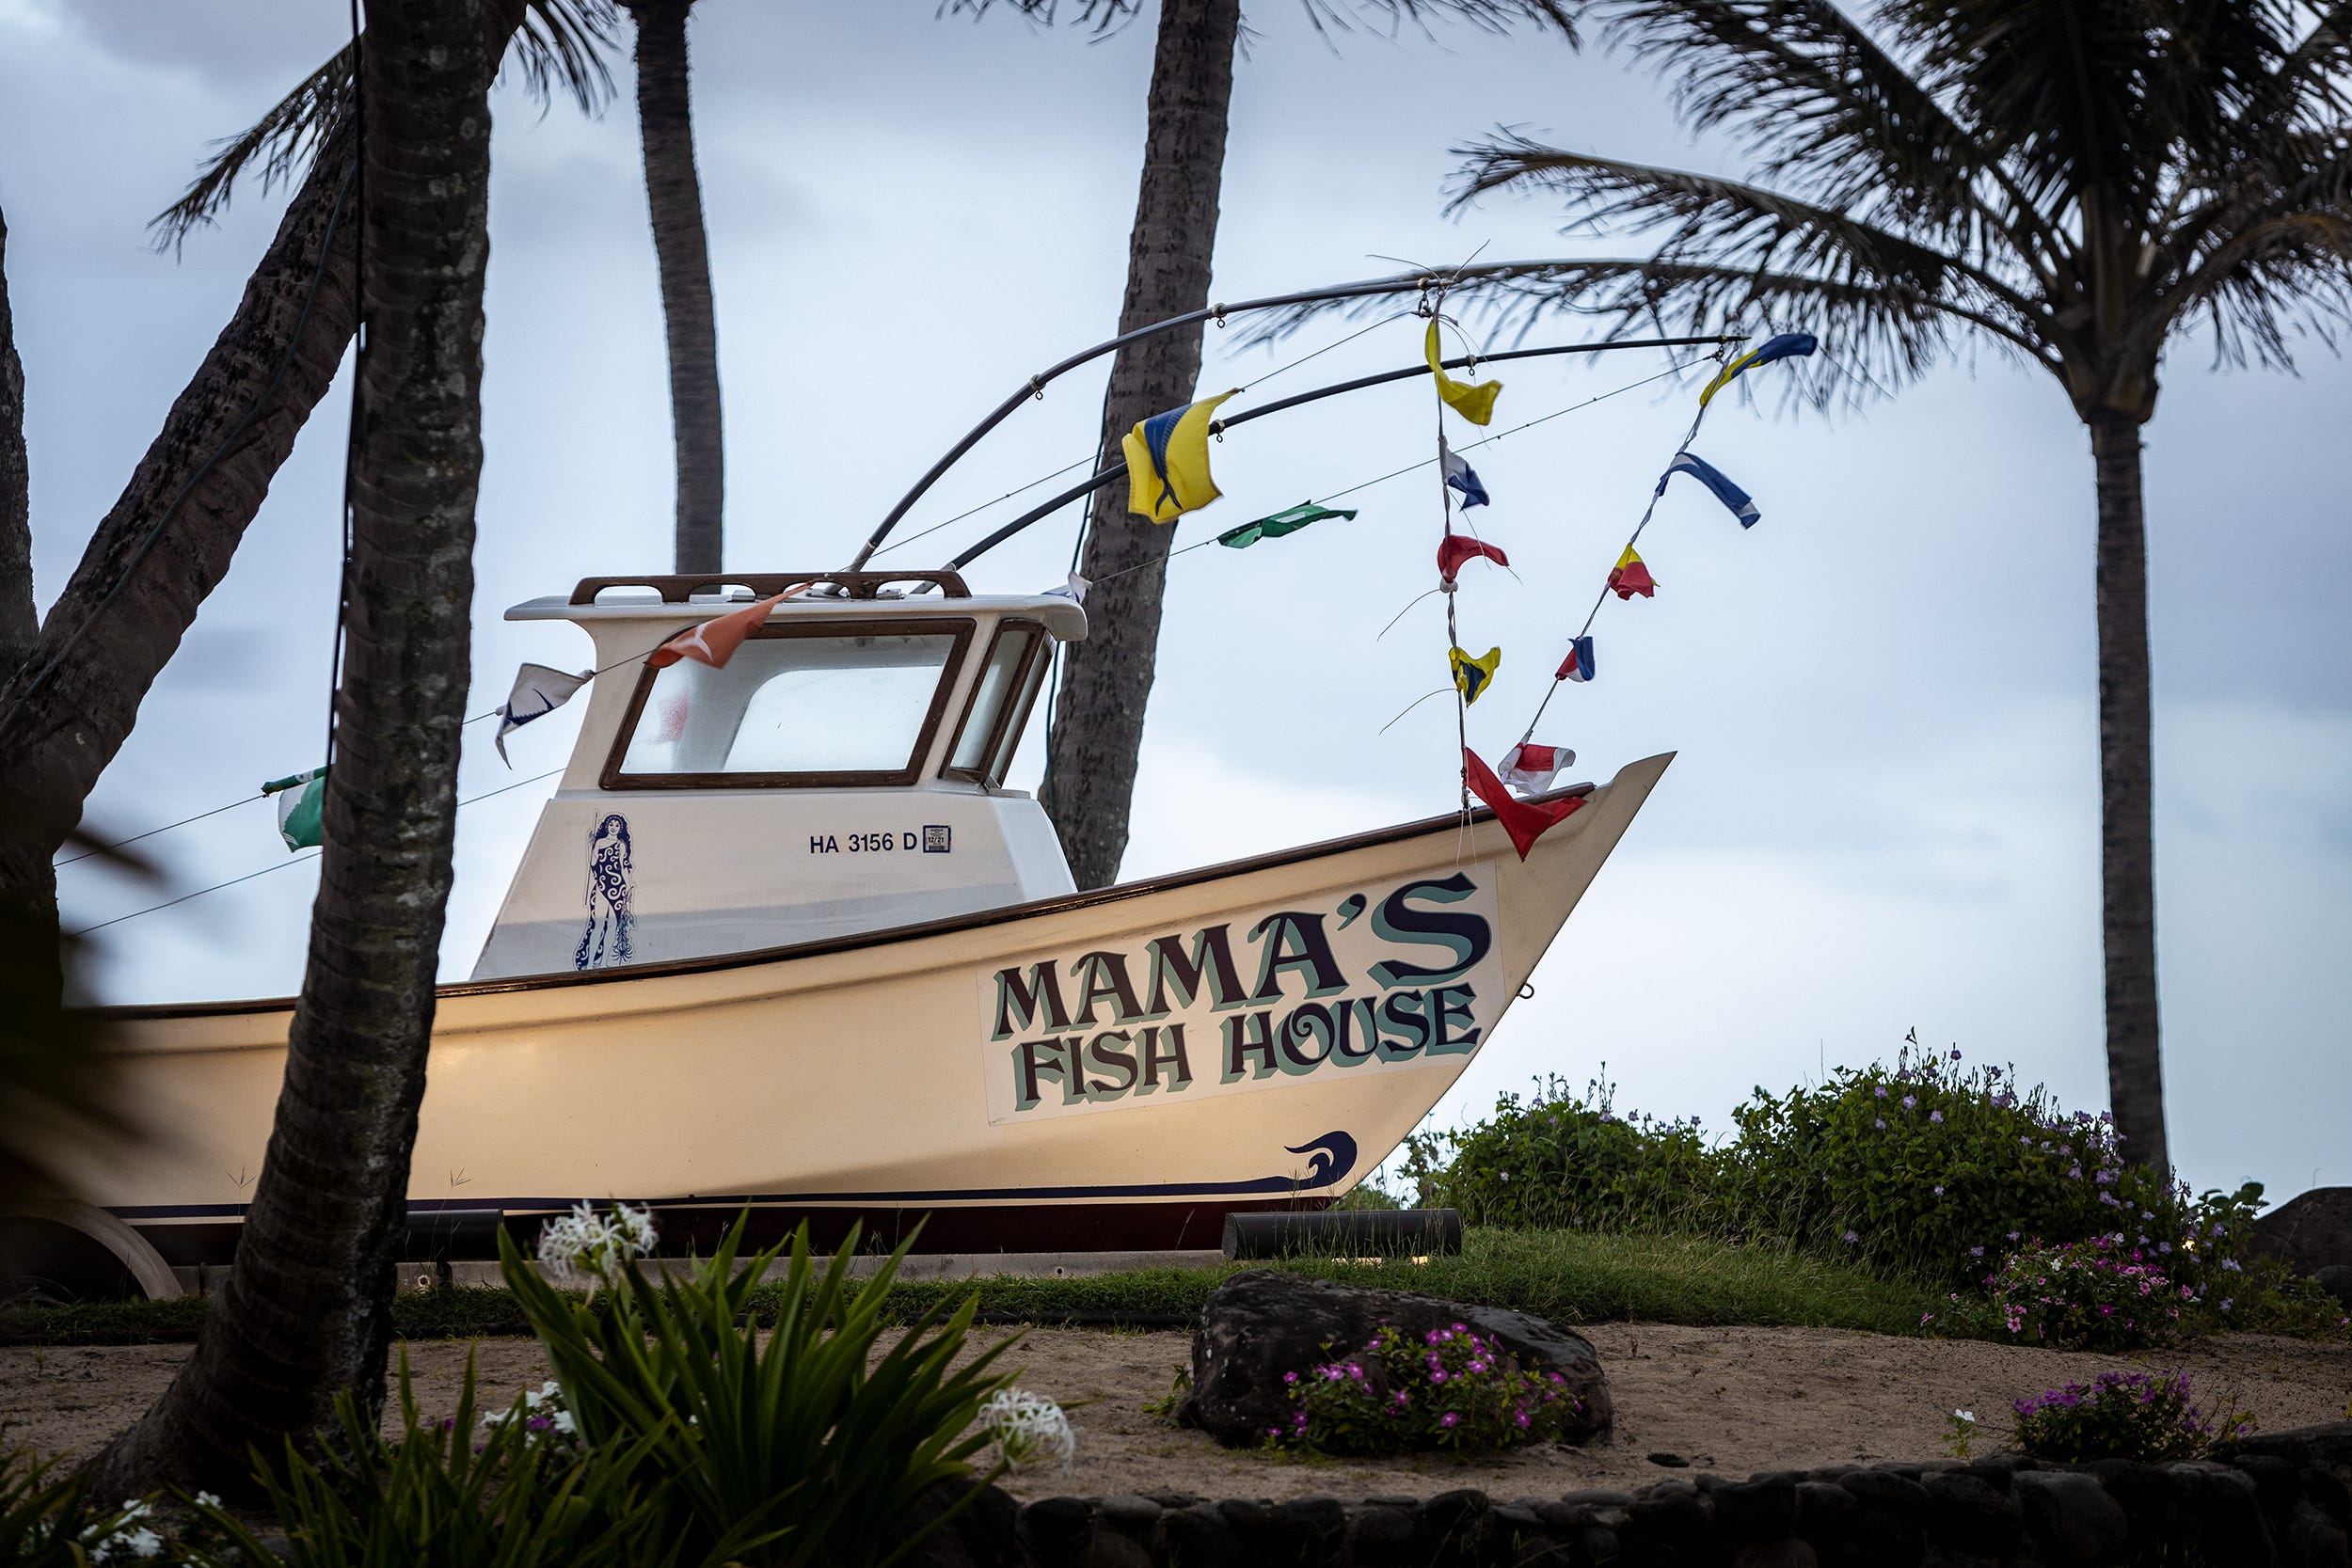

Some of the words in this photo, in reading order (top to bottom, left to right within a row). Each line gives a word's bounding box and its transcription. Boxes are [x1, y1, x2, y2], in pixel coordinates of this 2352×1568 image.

[810, 835, 839, 854] HA
[848, 832, 894, 853] 3156
[903, 832, 918, 850] D
[991, 871, 1492, 1041] MAMA'S
[1011, 1022, 1194, 1112] FISH
[1219, 982, 1484, 1085] HOUSE
